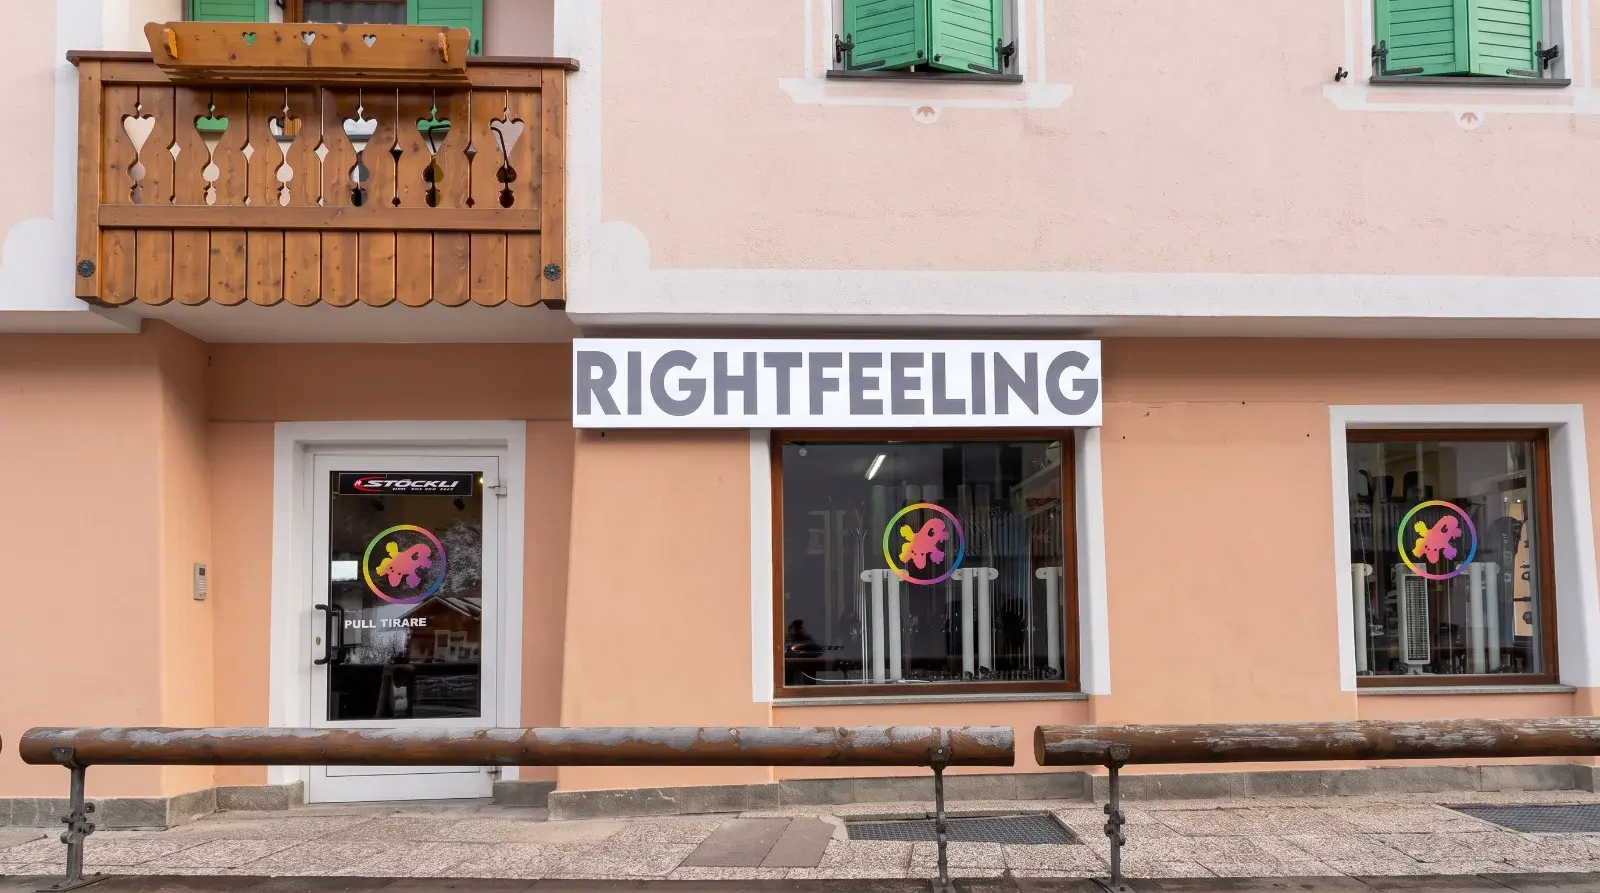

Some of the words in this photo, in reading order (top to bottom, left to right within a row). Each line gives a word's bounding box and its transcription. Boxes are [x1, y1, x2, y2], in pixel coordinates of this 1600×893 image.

[576, 350, 1099, 416] RIGHTFEELING
[344, 619, 377, 629] PULL
[379, 617, 428, 628] TIRARE
